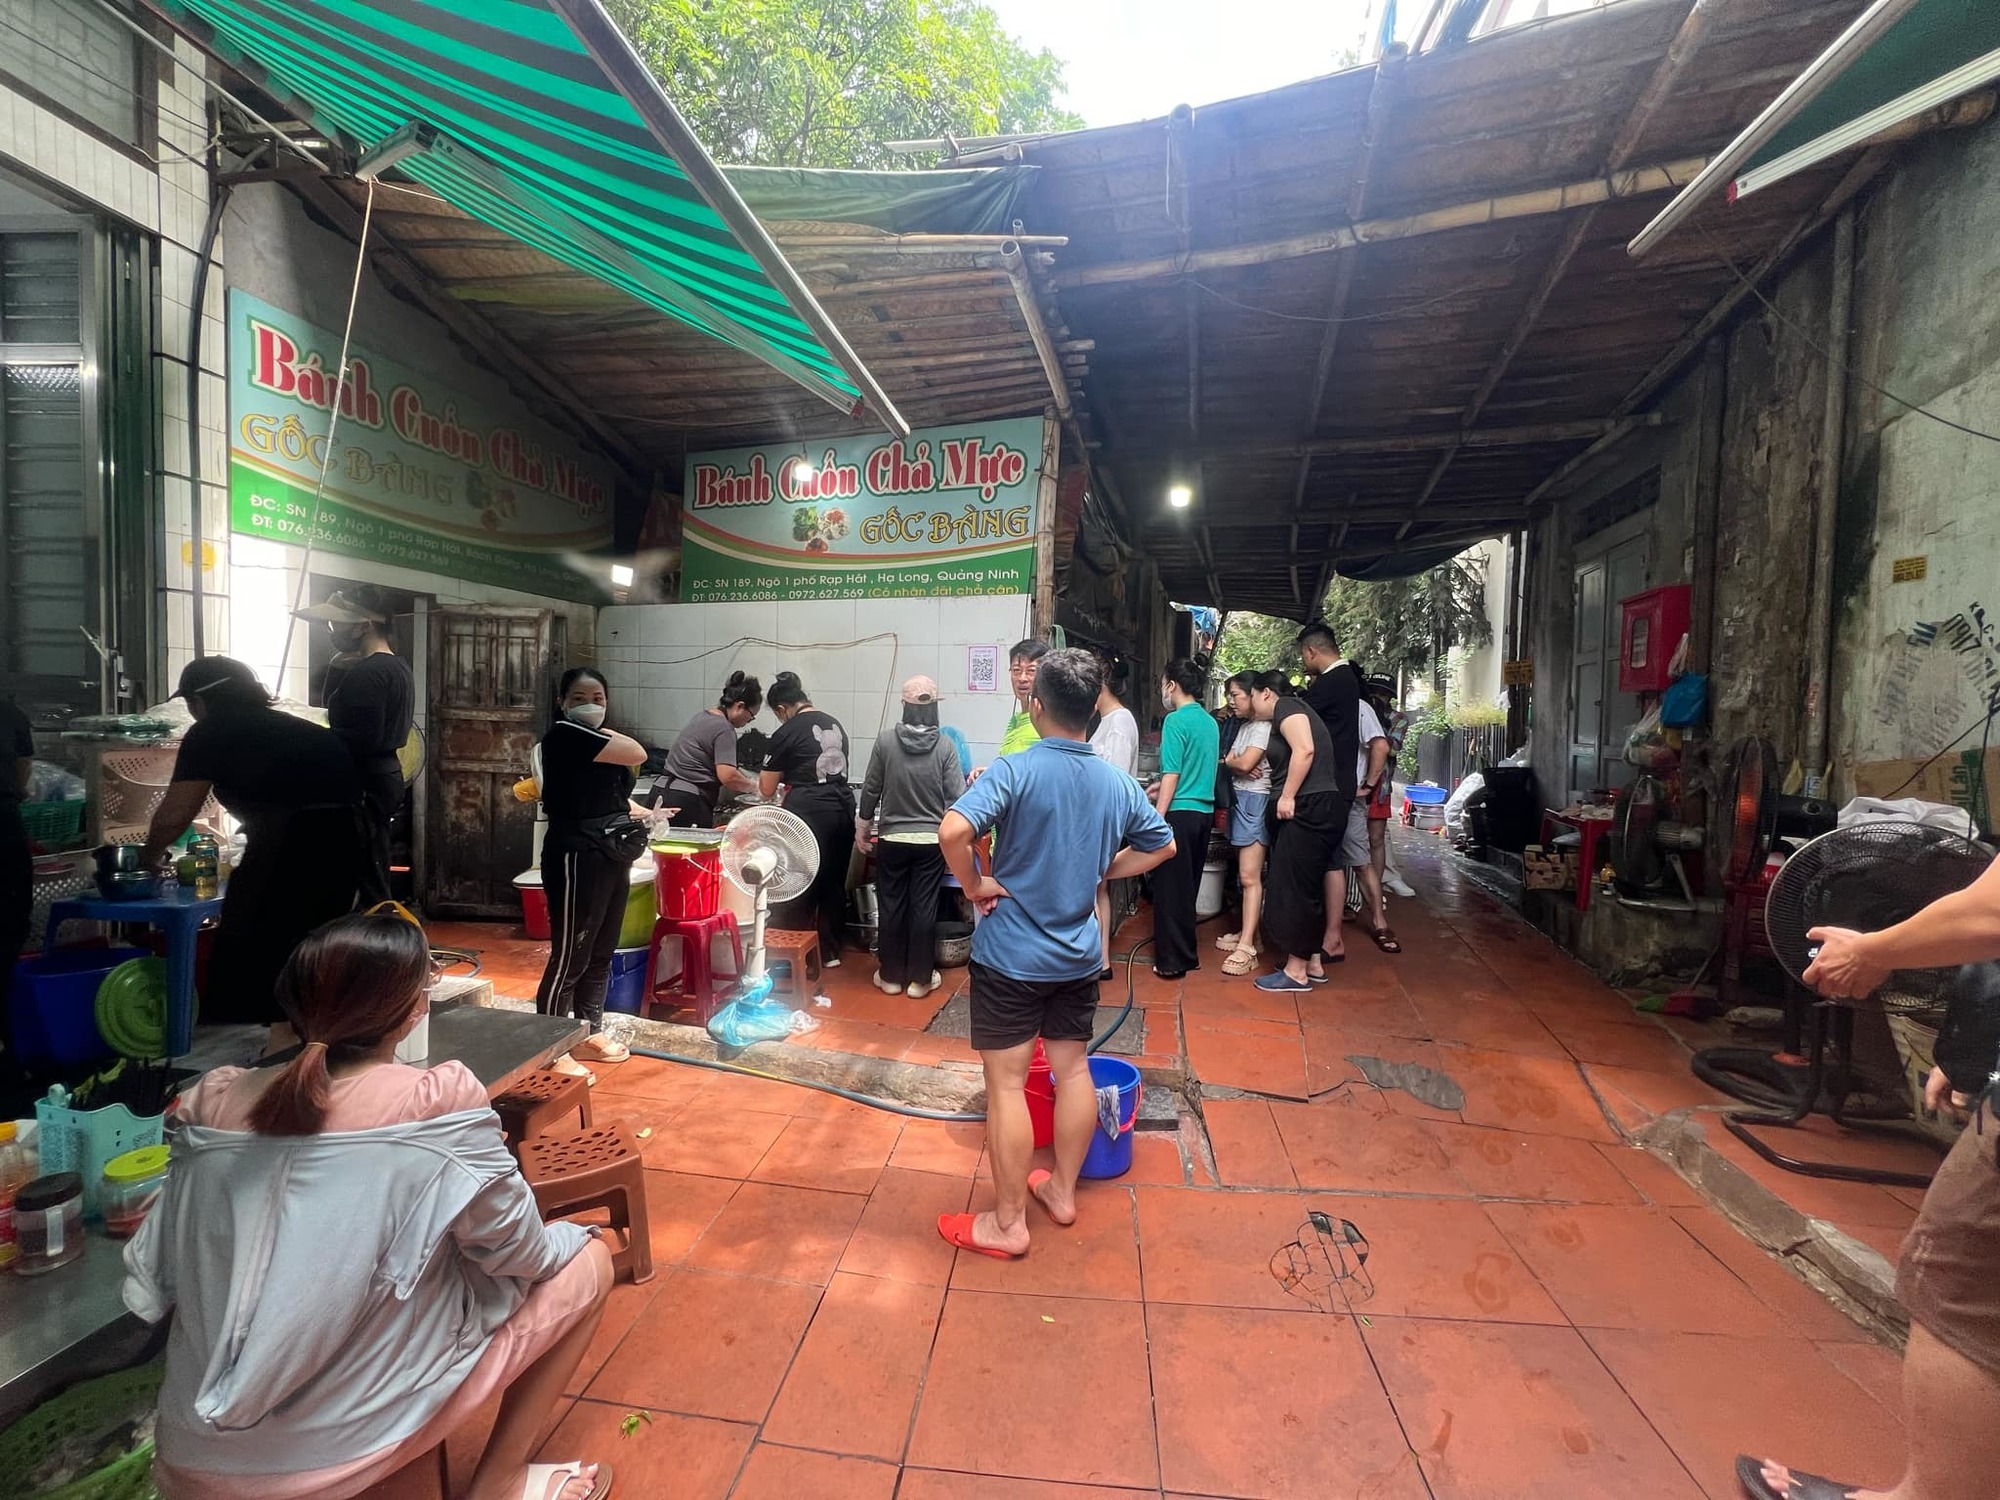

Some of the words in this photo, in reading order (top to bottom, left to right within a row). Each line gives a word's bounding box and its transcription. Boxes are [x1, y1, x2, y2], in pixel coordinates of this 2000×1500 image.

[250, 318, 384, 428] Bánh
[390, 385, 483, 467] Cuốn
[488, 427, 548, 491] Chả
[240, 412, 338, 472] GỐC
[694, 454, 773, 508] Bánh
[778, 449, 860, 499] Cuốn
[866, 440, 934, 495] Chả
[938, 437, 1027, 502] Mực
[250, 495, 281, 512] ĐC:
[285, 503, 307, 518] SN
[251, 513, 273, 529] ĐT:
[859, 507, 925, 544] GỐC
[928, 504, 1032, 545] BÀNG
[693, 579, 712, 589] ĐC:
[715, 578, 729, 588] SN
[793, 574, 816, 587] phố
[820, 575, 843, 586] Rạp
[878, 573, 896, 584] Hạ
[899, 572, 933, 584] Long,
[988, 569, 1019, 580] Ninh
[708, 591, 778, 602] 076.236.6086
[788, 589, 864, 600] 0972.627.569
